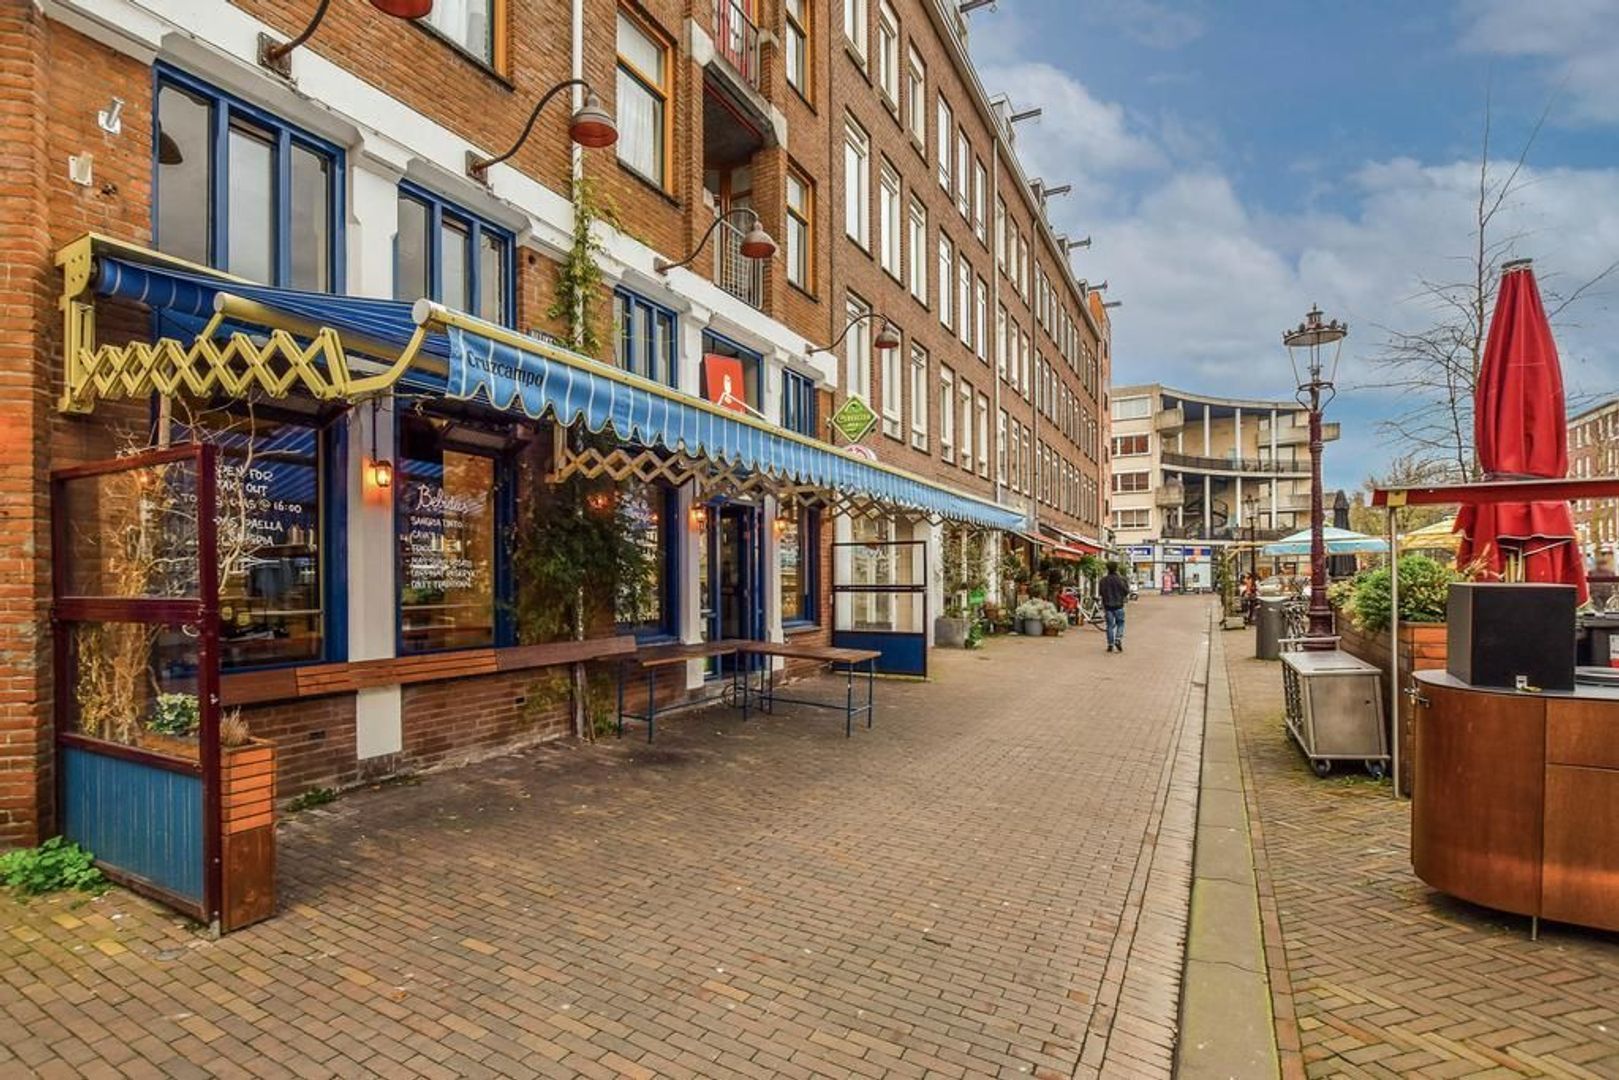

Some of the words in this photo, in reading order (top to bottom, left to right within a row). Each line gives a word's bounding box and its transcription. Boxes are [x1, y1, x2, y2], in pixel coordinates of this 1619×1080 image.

[466, 351, 544, 387] Cruzcampo
[249, 469, 273, 481] FOR
[245, 482, 268, 497] OUT
[273, 500, 303, 514] 16:00
